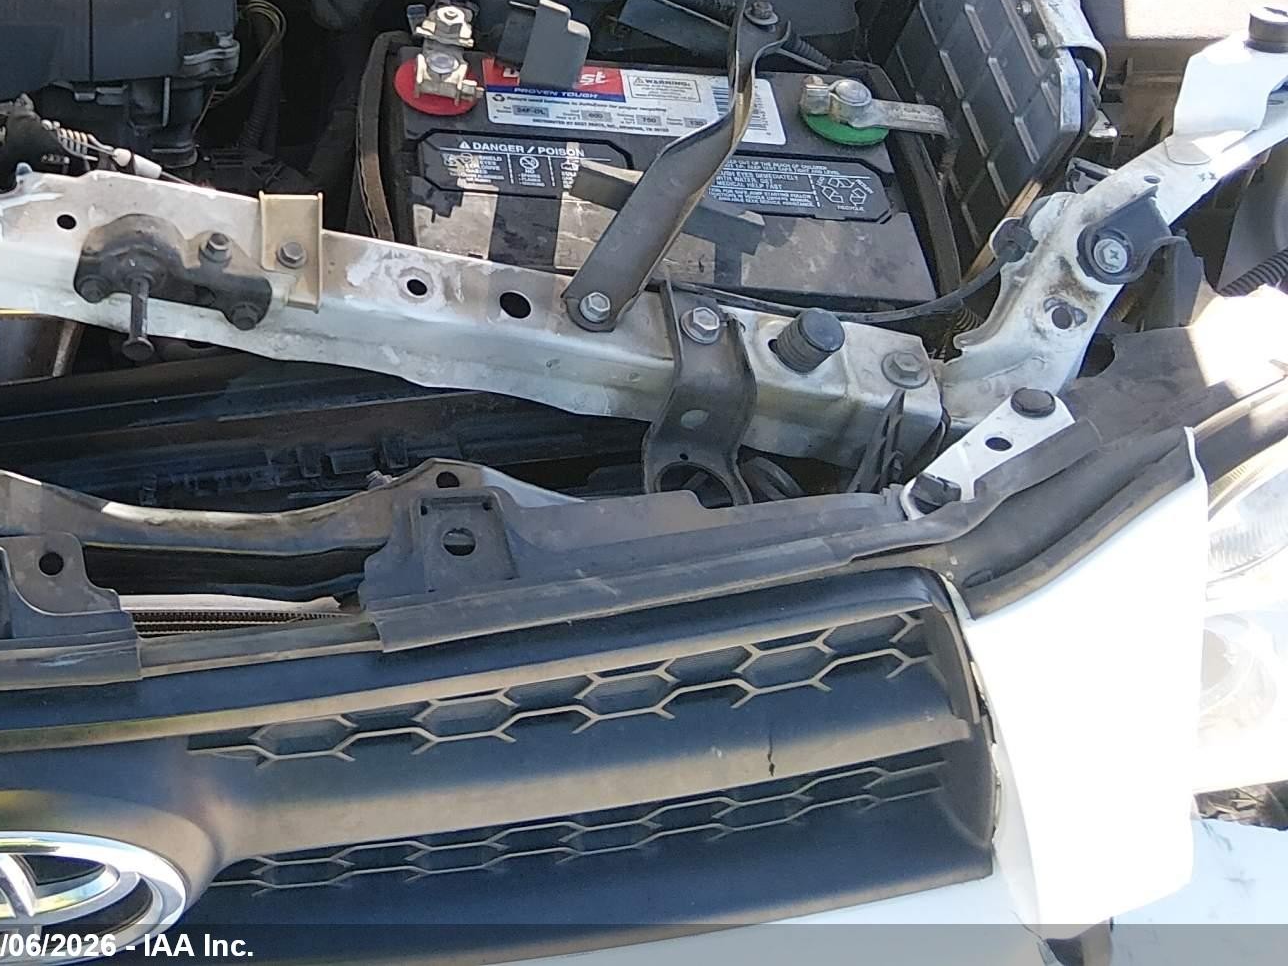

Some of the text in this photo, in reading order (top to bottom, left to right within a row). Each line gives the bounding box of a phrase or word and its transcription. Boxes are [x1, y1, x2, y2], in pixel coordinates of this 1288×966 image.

[514, 87, 598, 99] PROVEN TOUGH
[472, 141, 585, 157] DANGER / POISON
